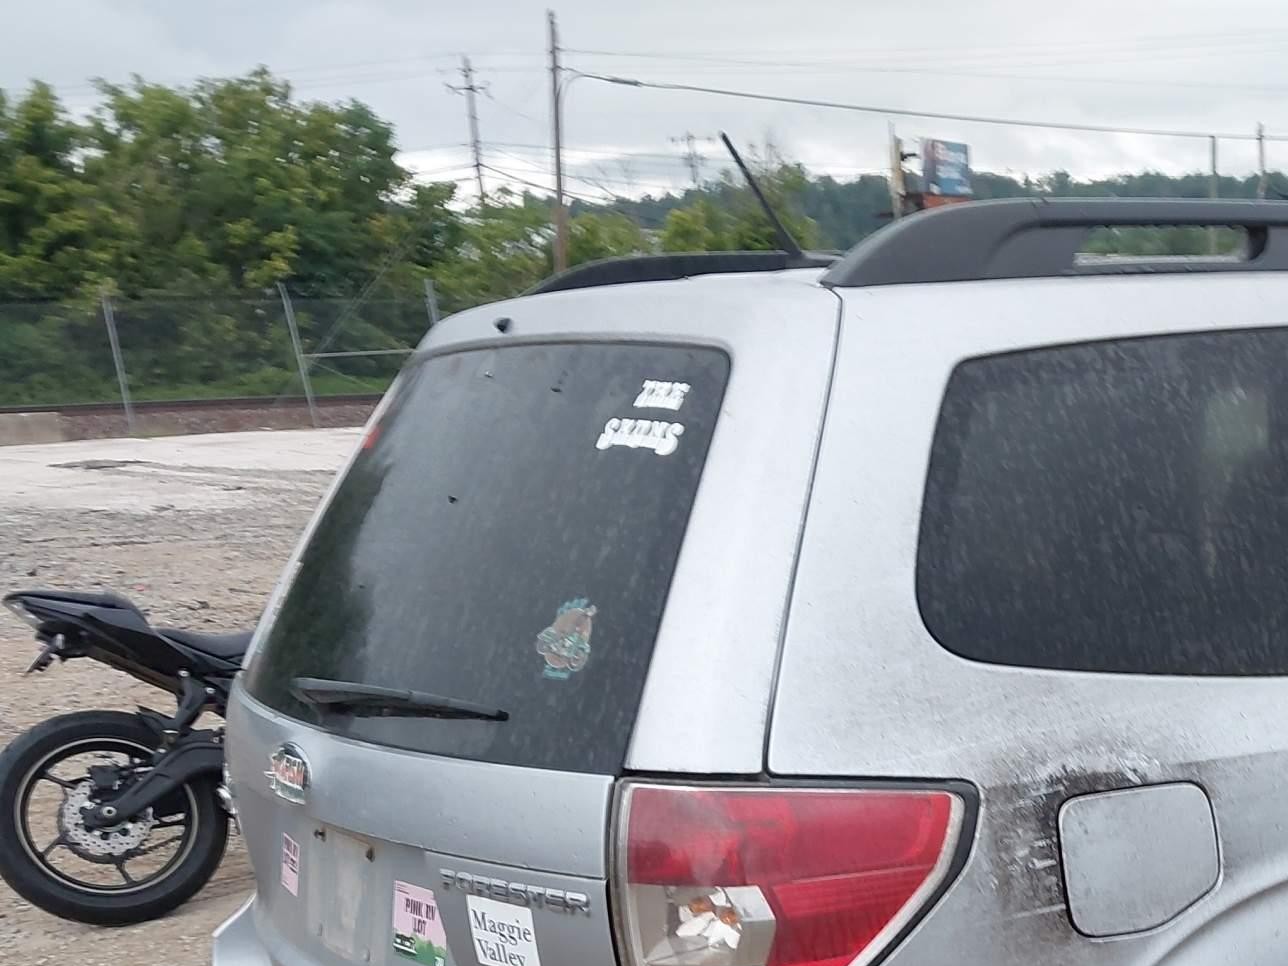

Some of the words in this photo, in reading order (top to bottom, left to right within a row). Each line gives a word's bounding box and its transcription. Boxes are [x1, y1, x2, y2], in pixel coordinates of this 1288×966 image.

[440, 868, 590, 914] FORESTER
[405, 898, 424, 917] PINK
[413, 918, 427, 936] LOT
[471, 908, 533, 945] Maggie
